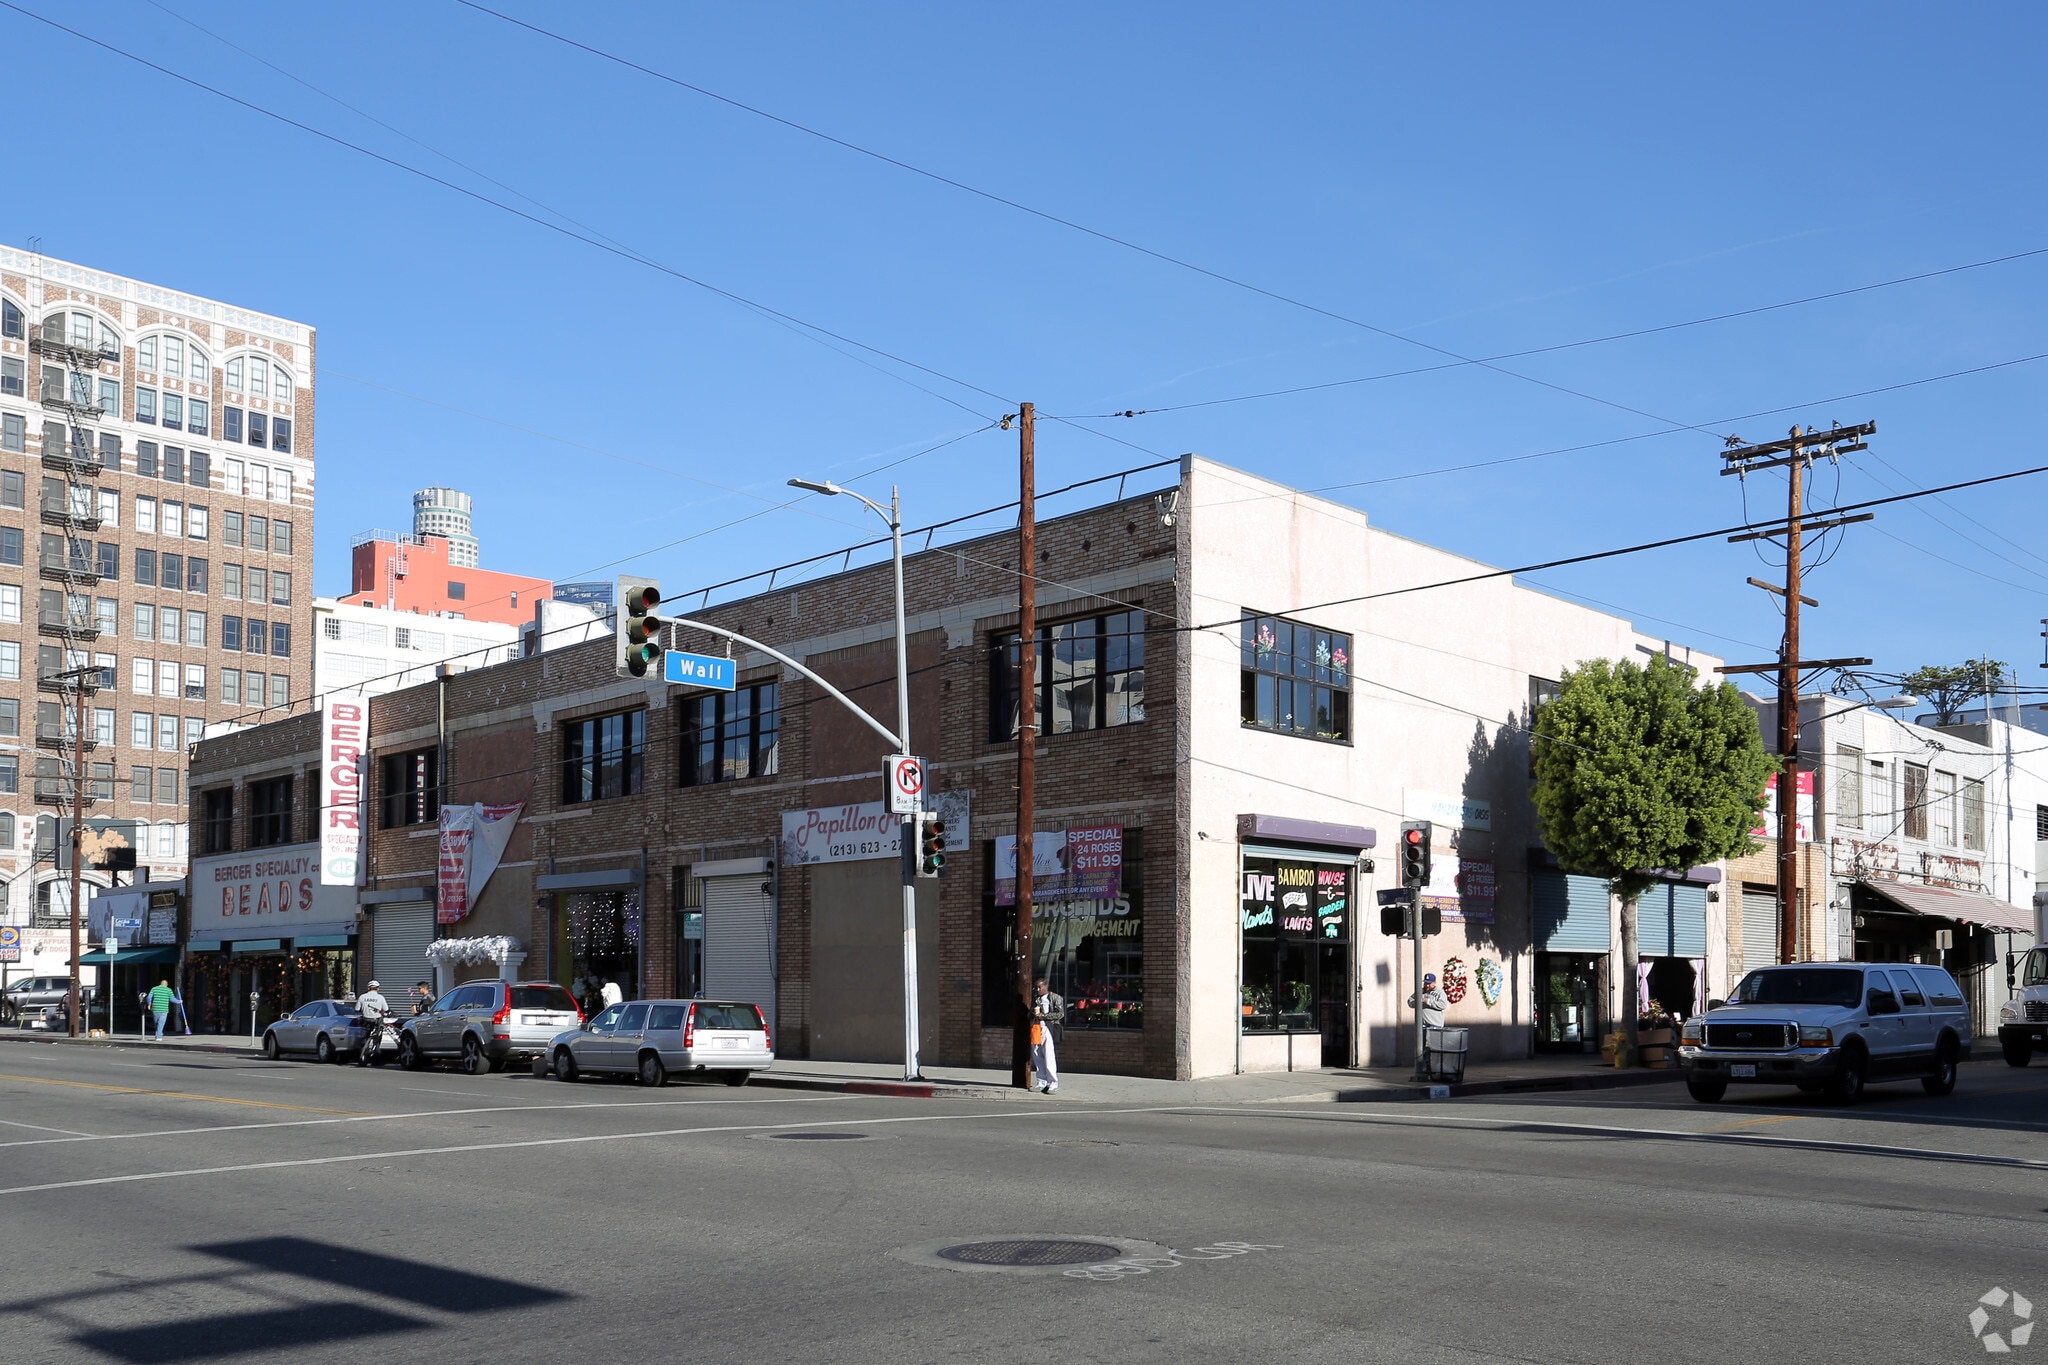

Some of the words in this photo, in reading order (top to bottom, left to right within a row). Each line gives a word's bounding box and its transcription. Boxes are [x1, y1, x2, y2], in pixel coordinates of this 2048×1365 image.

[681, 659, 721, 680] Wall
[330, 703, 362, 829] BERGER
[796, 806, 876, 847] Papillon
[878, 812, 901, 834] Fl
[944, 817, 960, 825] OWERS
[327, 834, 363, 845] SPECIALTY
[1068, 829, 1121, 843] SPECIAL
[829, 843, 856, 857] (213)
[860, 841, 880, 854] 623
[891, 839, 902, 851] 27
[1077, 845, 1089, 855] 24
[1091, 842, 1122, 853] ROSES
[214, 864, 252, 883] BERGER
[255, 857, 310, 878] SPECIALTY
[331, 860, 355, 873] 413
[1076, 854, 1121, 870] $11.99
[1461, 861, 1495, 874] SPECIAL
[1278, 867, 1315, 887] BAMBOO
[1318, 870, 1346, 886] HOUSE
[1467, 874, 1475, 883] 24
[222, 877, 314, 917] BEADS
[1327, 886, 1336, 900] &
[1467, 884, 1495, 897] $11.99
[1032, 892, 1131, 918] ORCHIDS
[1284, 893, 1305, 907] DESERT
[1318, 899, 1346, 917] GARDEN
[1059, 919, 1141, 938] ARRANGEMENT
